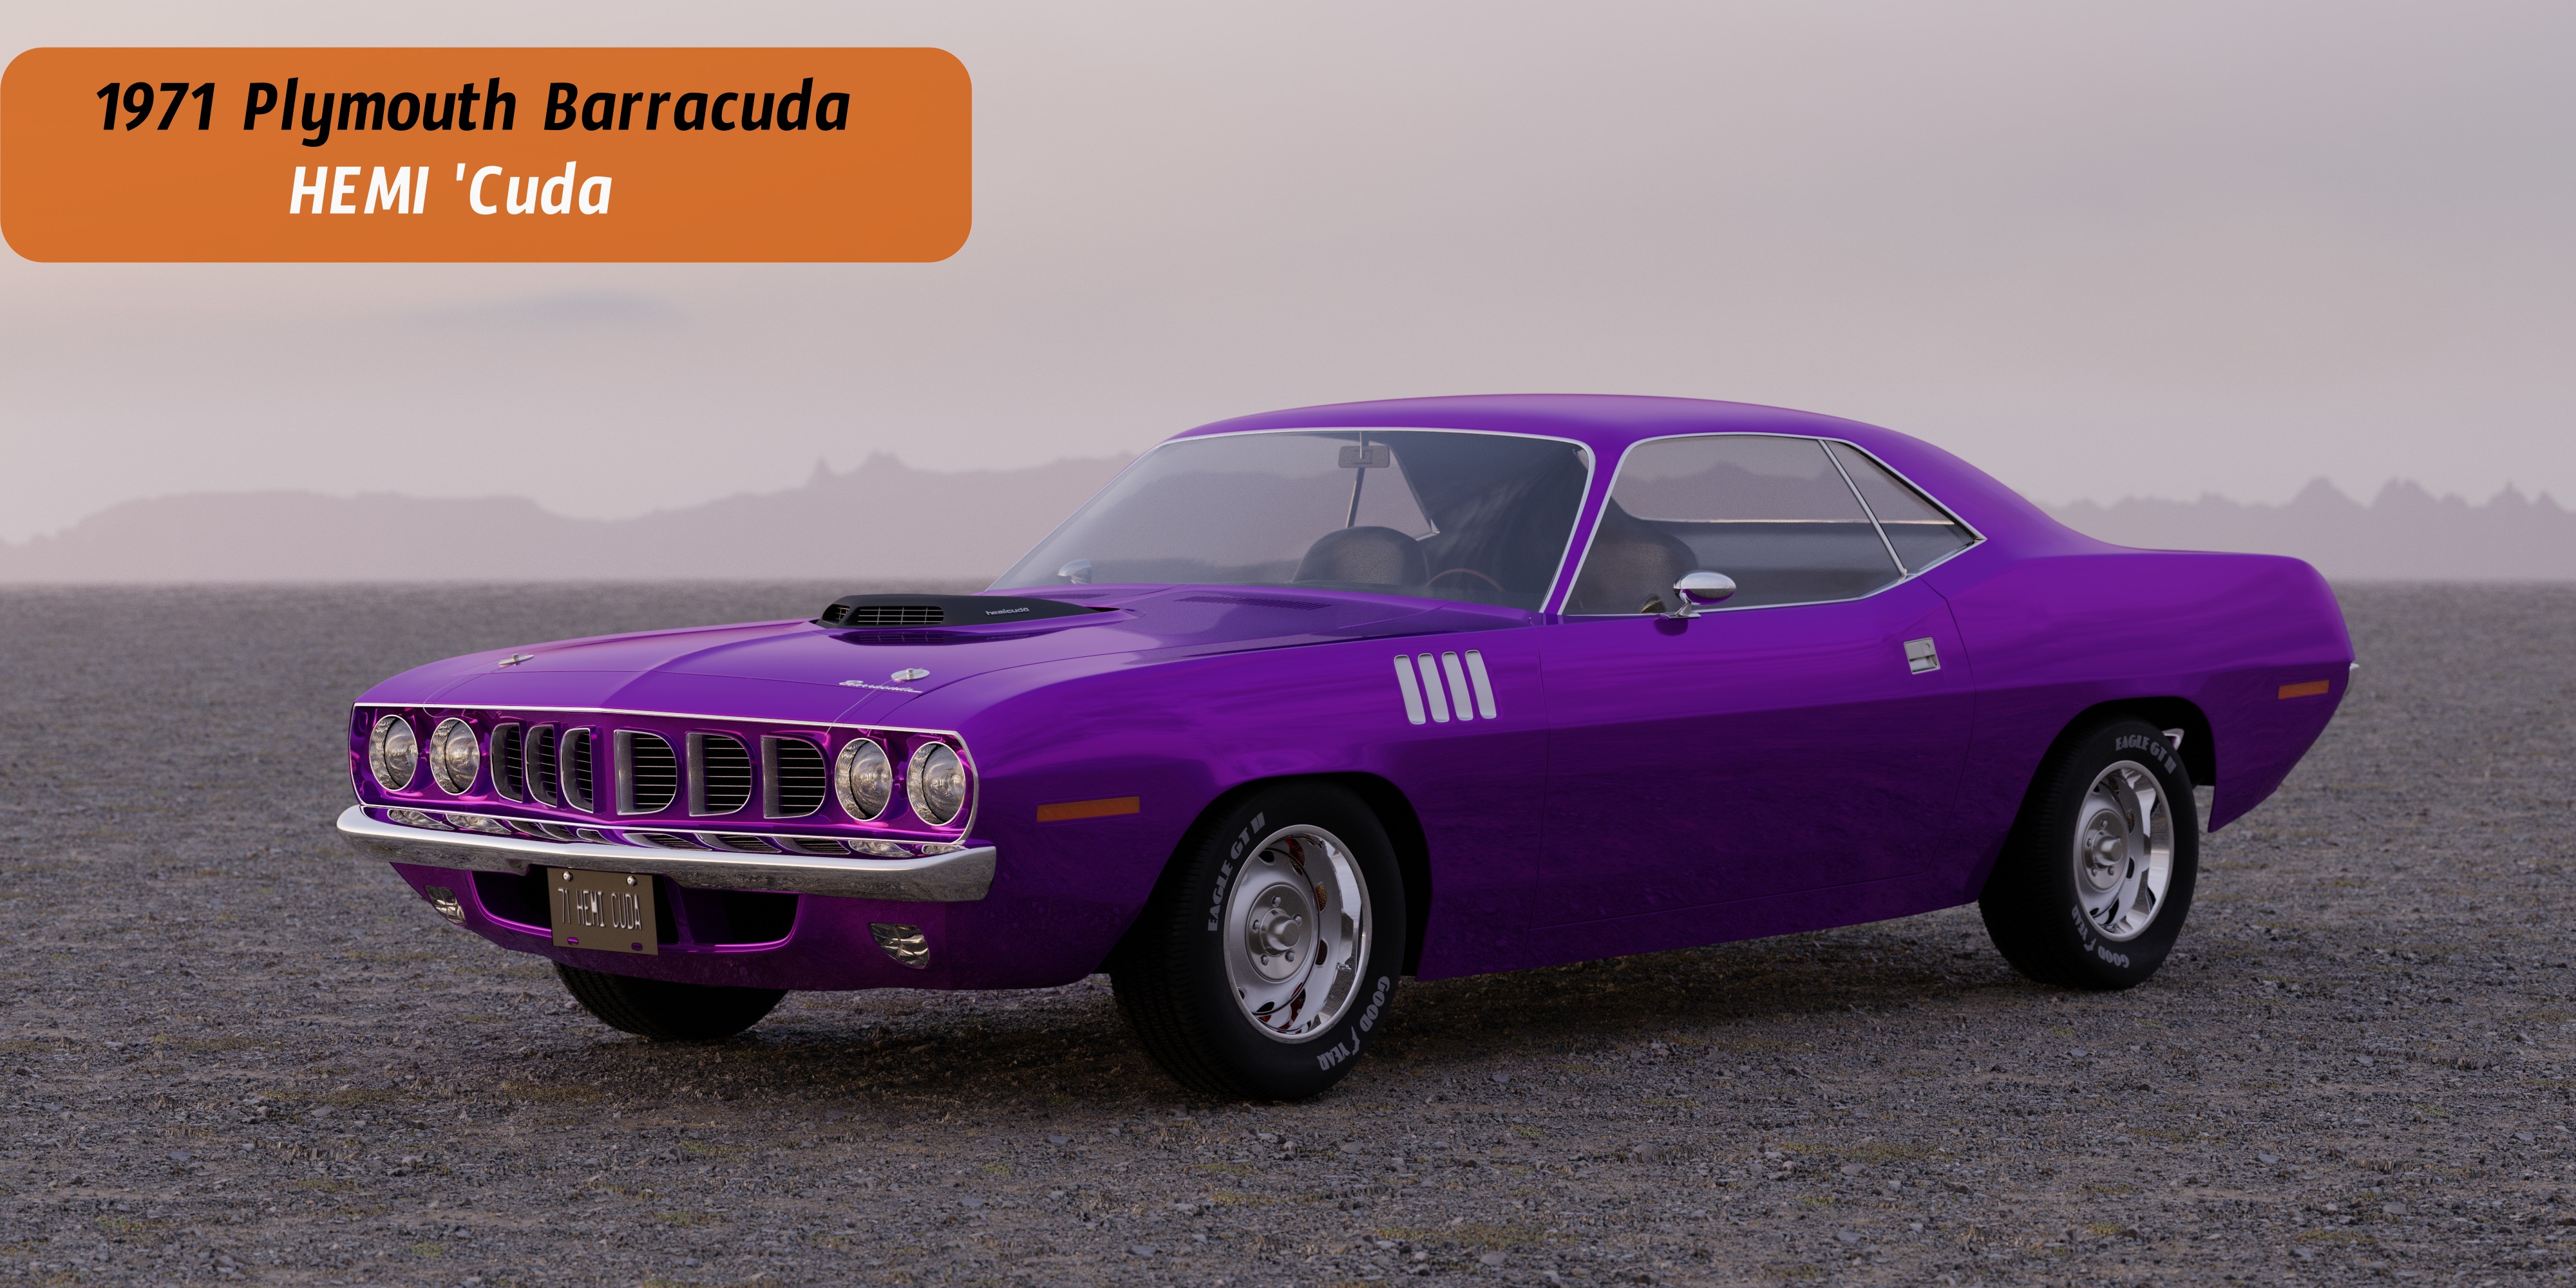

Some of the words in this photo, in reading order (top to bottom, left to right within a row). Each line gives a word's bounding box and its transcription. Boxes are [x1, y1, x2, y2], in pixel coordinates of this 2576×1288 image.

[985, 607, 1030, 616] hemicuda
[2115, 734, 2150, 752] EAGLE
[2150, 741, 2168, 762] GT
[1208, 859, 1233, 931] EAGLE
[1231, 826, 1251, 860] GT
[558, 887, 571, 924] 71
[576, 888, 605, 927] HEMI
[611, 892, 642, 931] CUDA
[2071, 904, 2088, 942] YEAR
[2098, 945, 2130, 969] GOOD
[1359, 976, 1390, 1032] GOOD
[1316, 1041, 1350, 1071] YEAR
